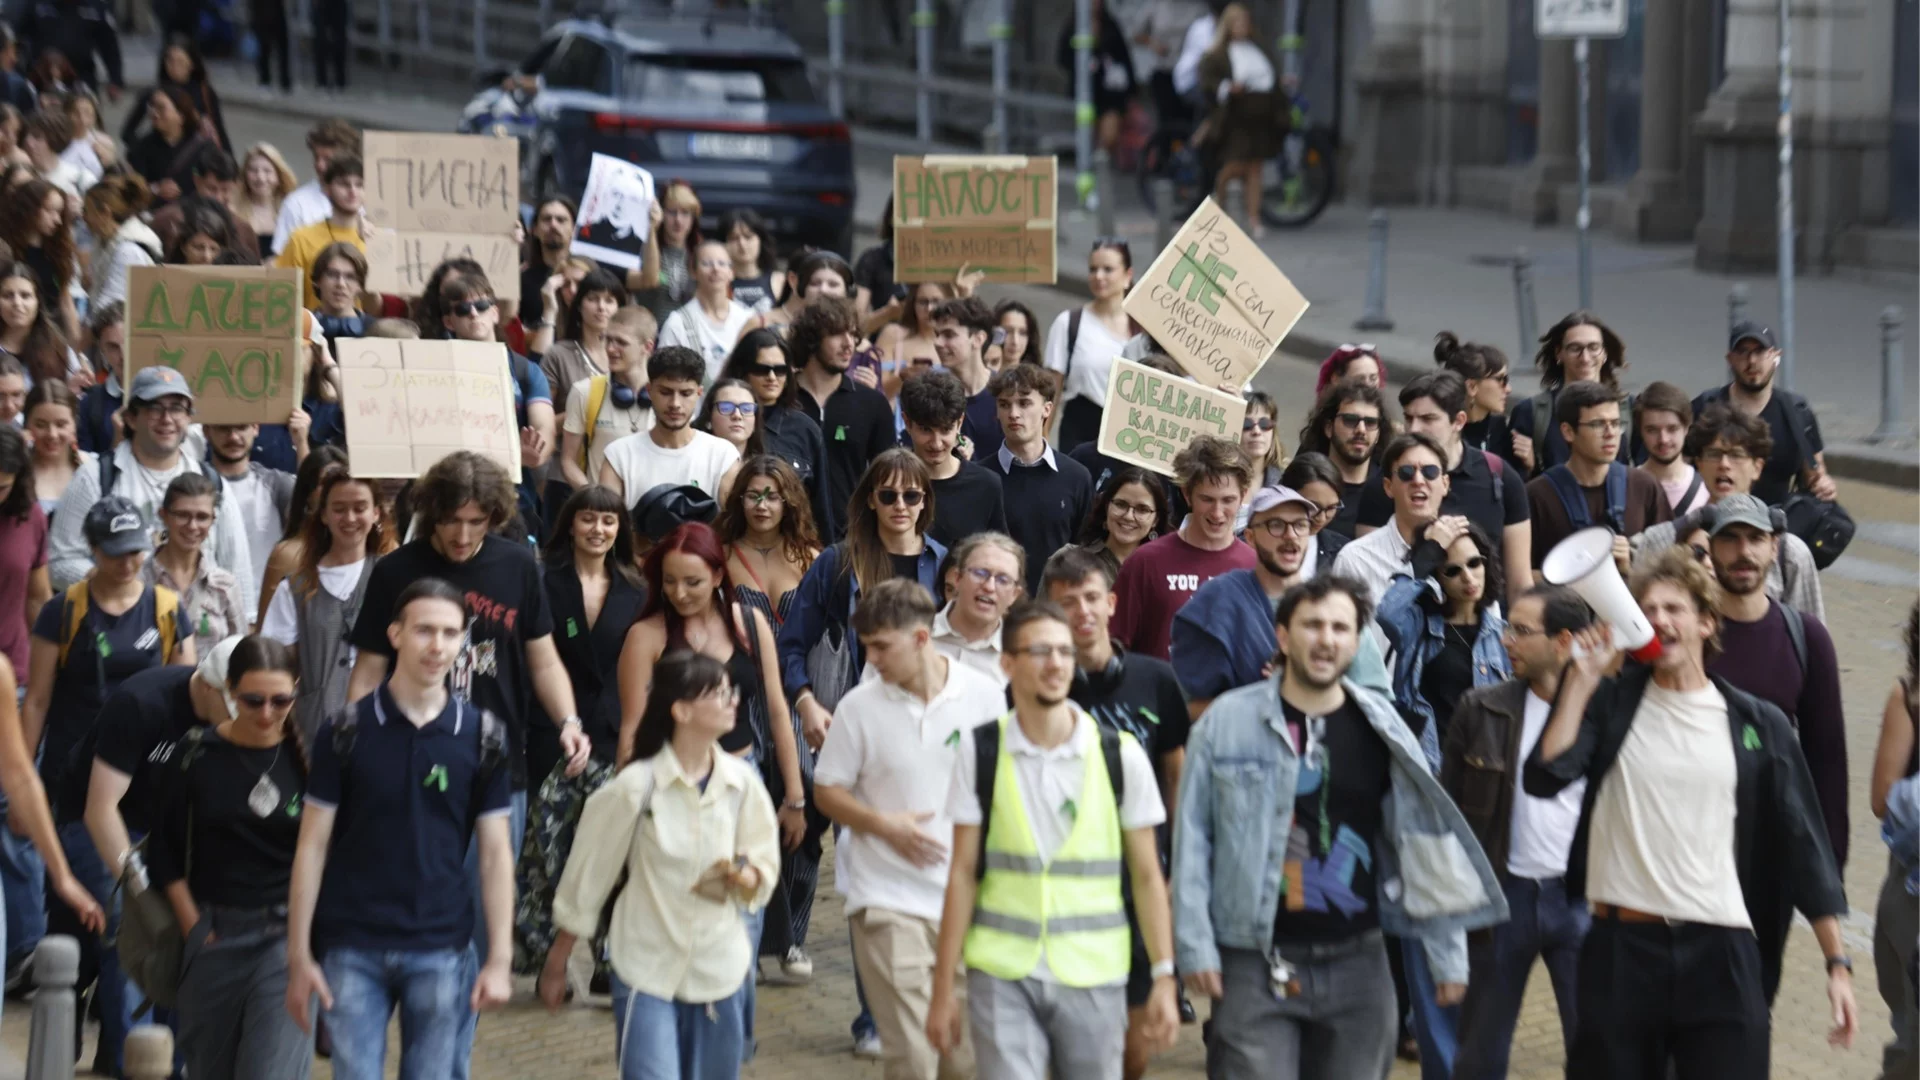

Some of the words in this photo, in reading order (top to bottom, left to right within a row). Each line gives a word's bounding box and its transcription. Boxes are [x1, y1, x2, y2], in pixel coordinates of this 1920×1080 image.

[377, 158, 513, 212] ПИСНА
[900, 170, 1049, 223] НАГЛОСТ
[960, 237, 1043, 259] МОРЕТА
[1167, 241, 1238, 317] НЕ
[1116, 370, 1227, 434] СЛЕДВАЩ
[1166, 574, 1199, 591] YOU
